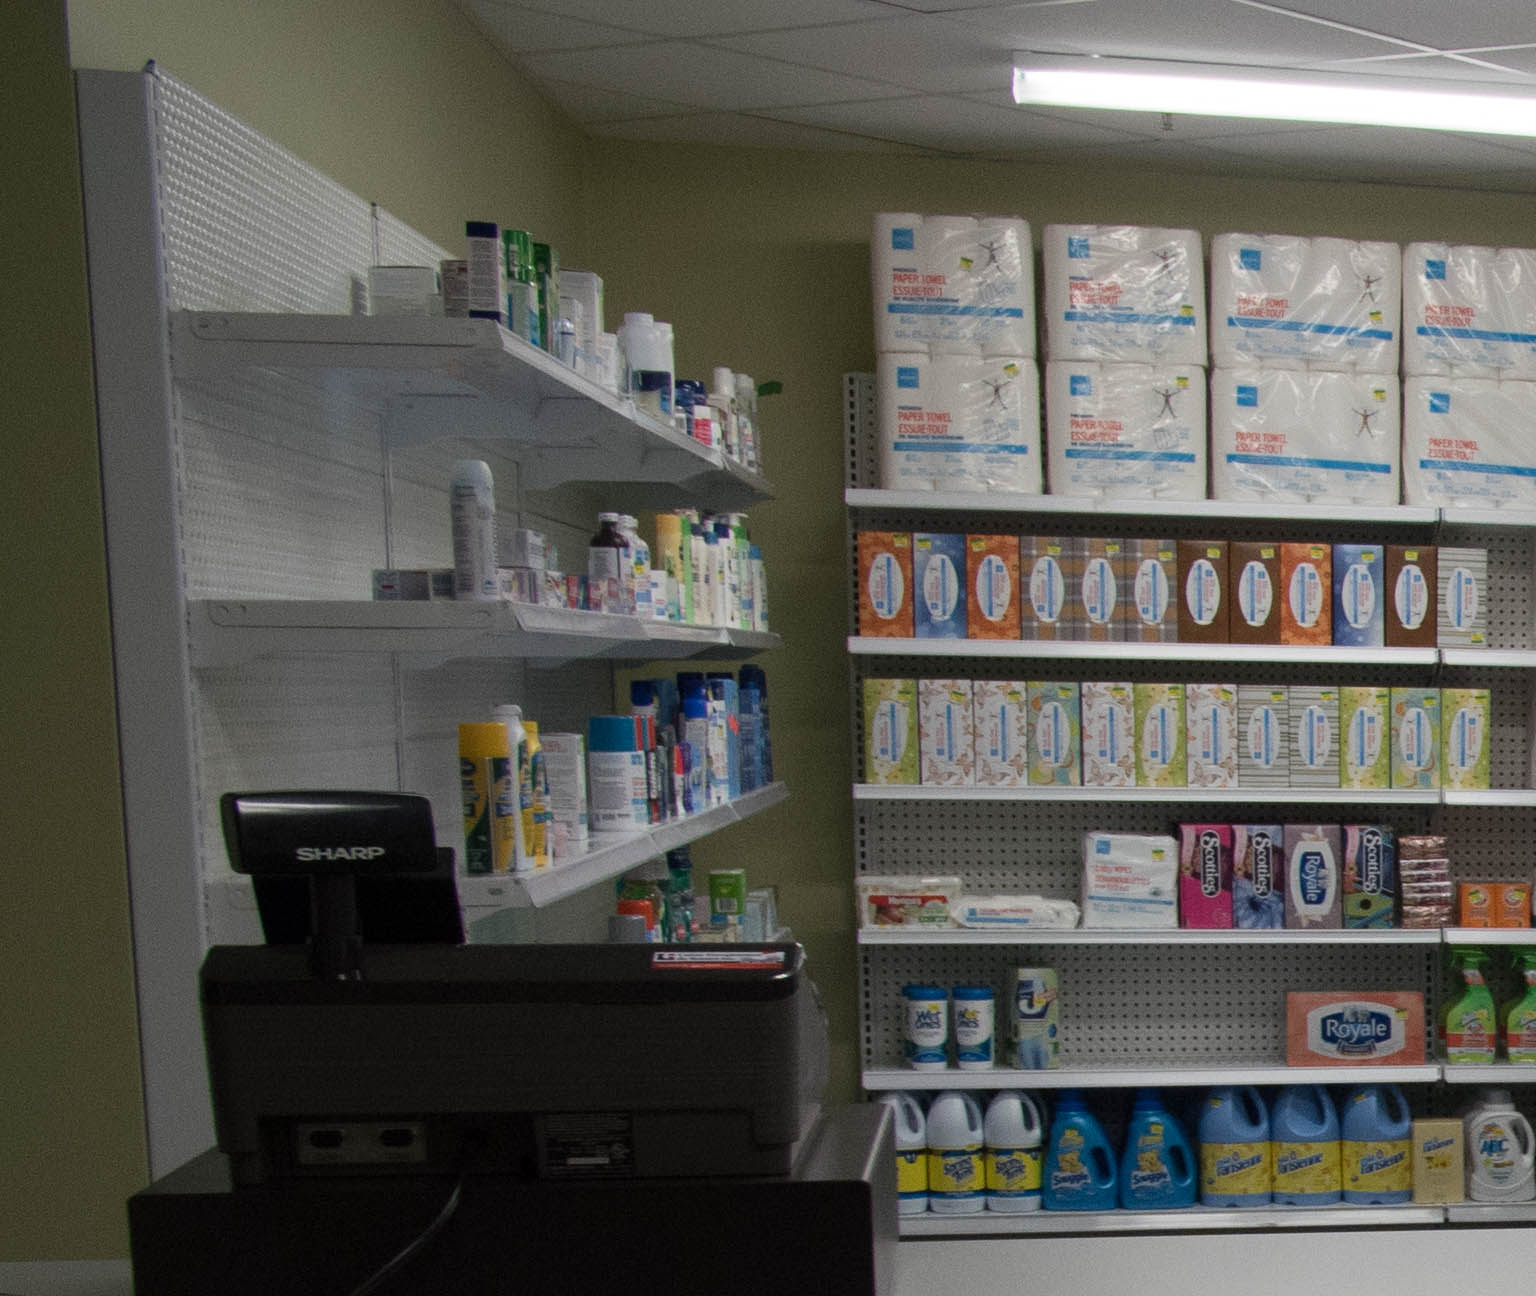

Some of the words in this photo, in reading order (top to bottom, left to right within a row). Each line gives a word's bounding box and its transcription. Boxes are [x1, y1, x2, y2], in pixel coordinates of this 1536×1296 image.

[295, 846, 386, 862] SHARP
[1200, 830, 1220, 898] Scotties
[1252, 831, 1272, 899] Scotties
[1363, 828, 1383, 895] Scotties
[1304, 855, 1321, 905] Royale
[1326, 1016, 1389, 1040] Royale
[1481, 1138, 1509, 1155] ABC
[1053, 1173, 1090, 1187] Snuggle
[1133, 1172, 1169, 1187] Snuggle
